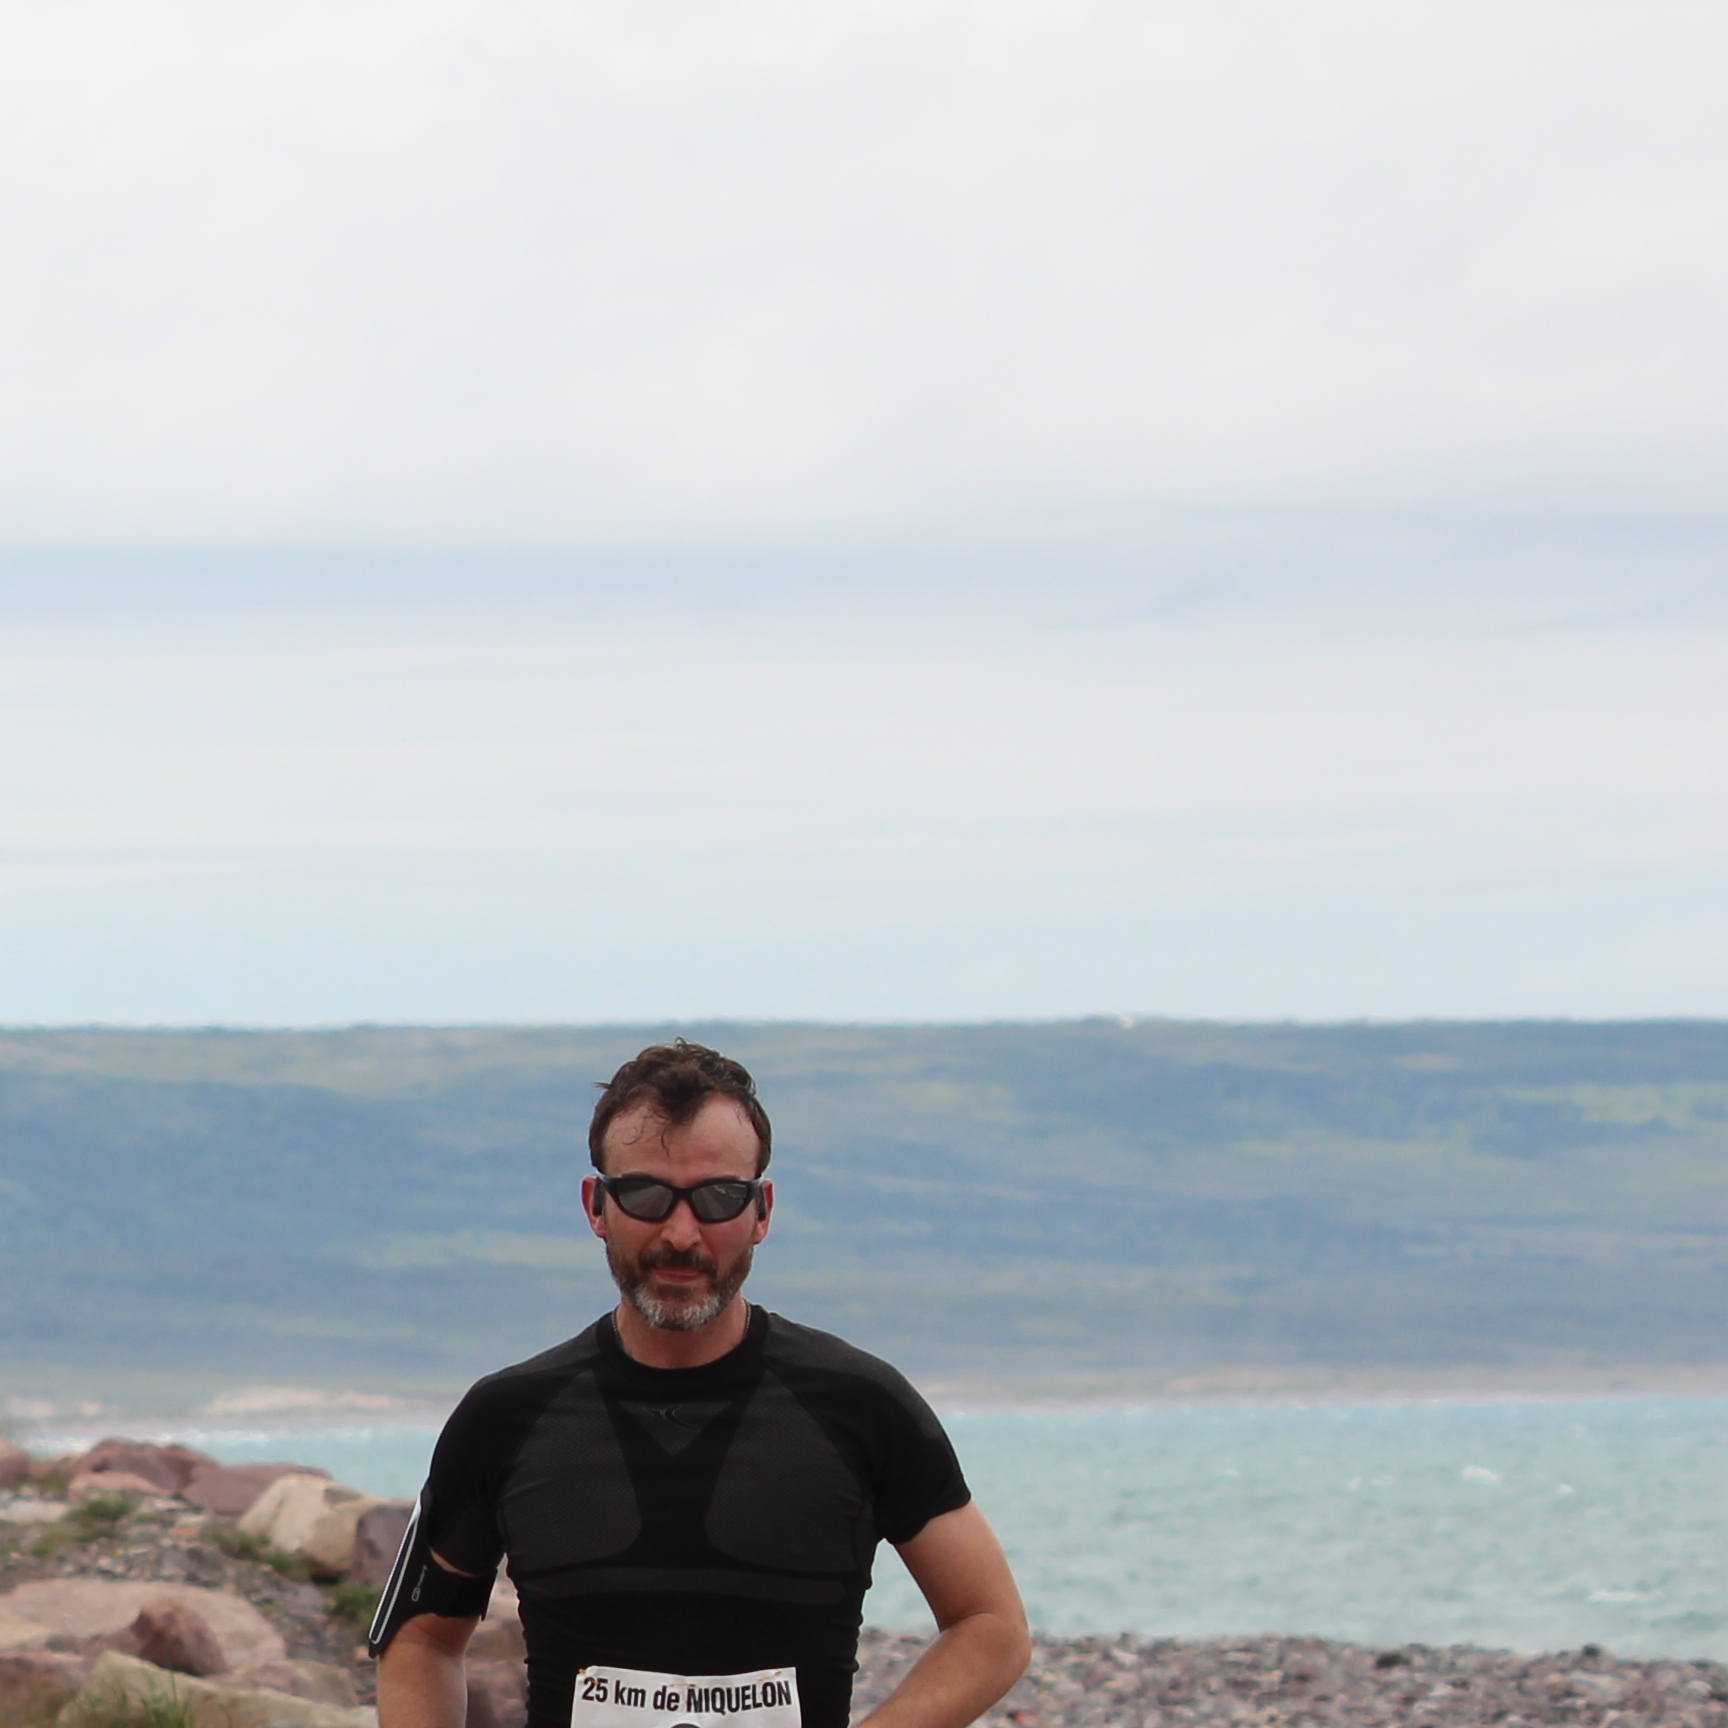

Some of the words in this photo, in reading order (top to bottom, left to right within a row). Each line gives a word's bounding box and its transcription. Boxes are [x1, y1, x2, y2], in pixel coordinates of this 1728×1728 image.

[581, 1677, 608, 1703] 25
[614, 1681, 646, 1709] km
[653, 1684, 680, 1713] de
